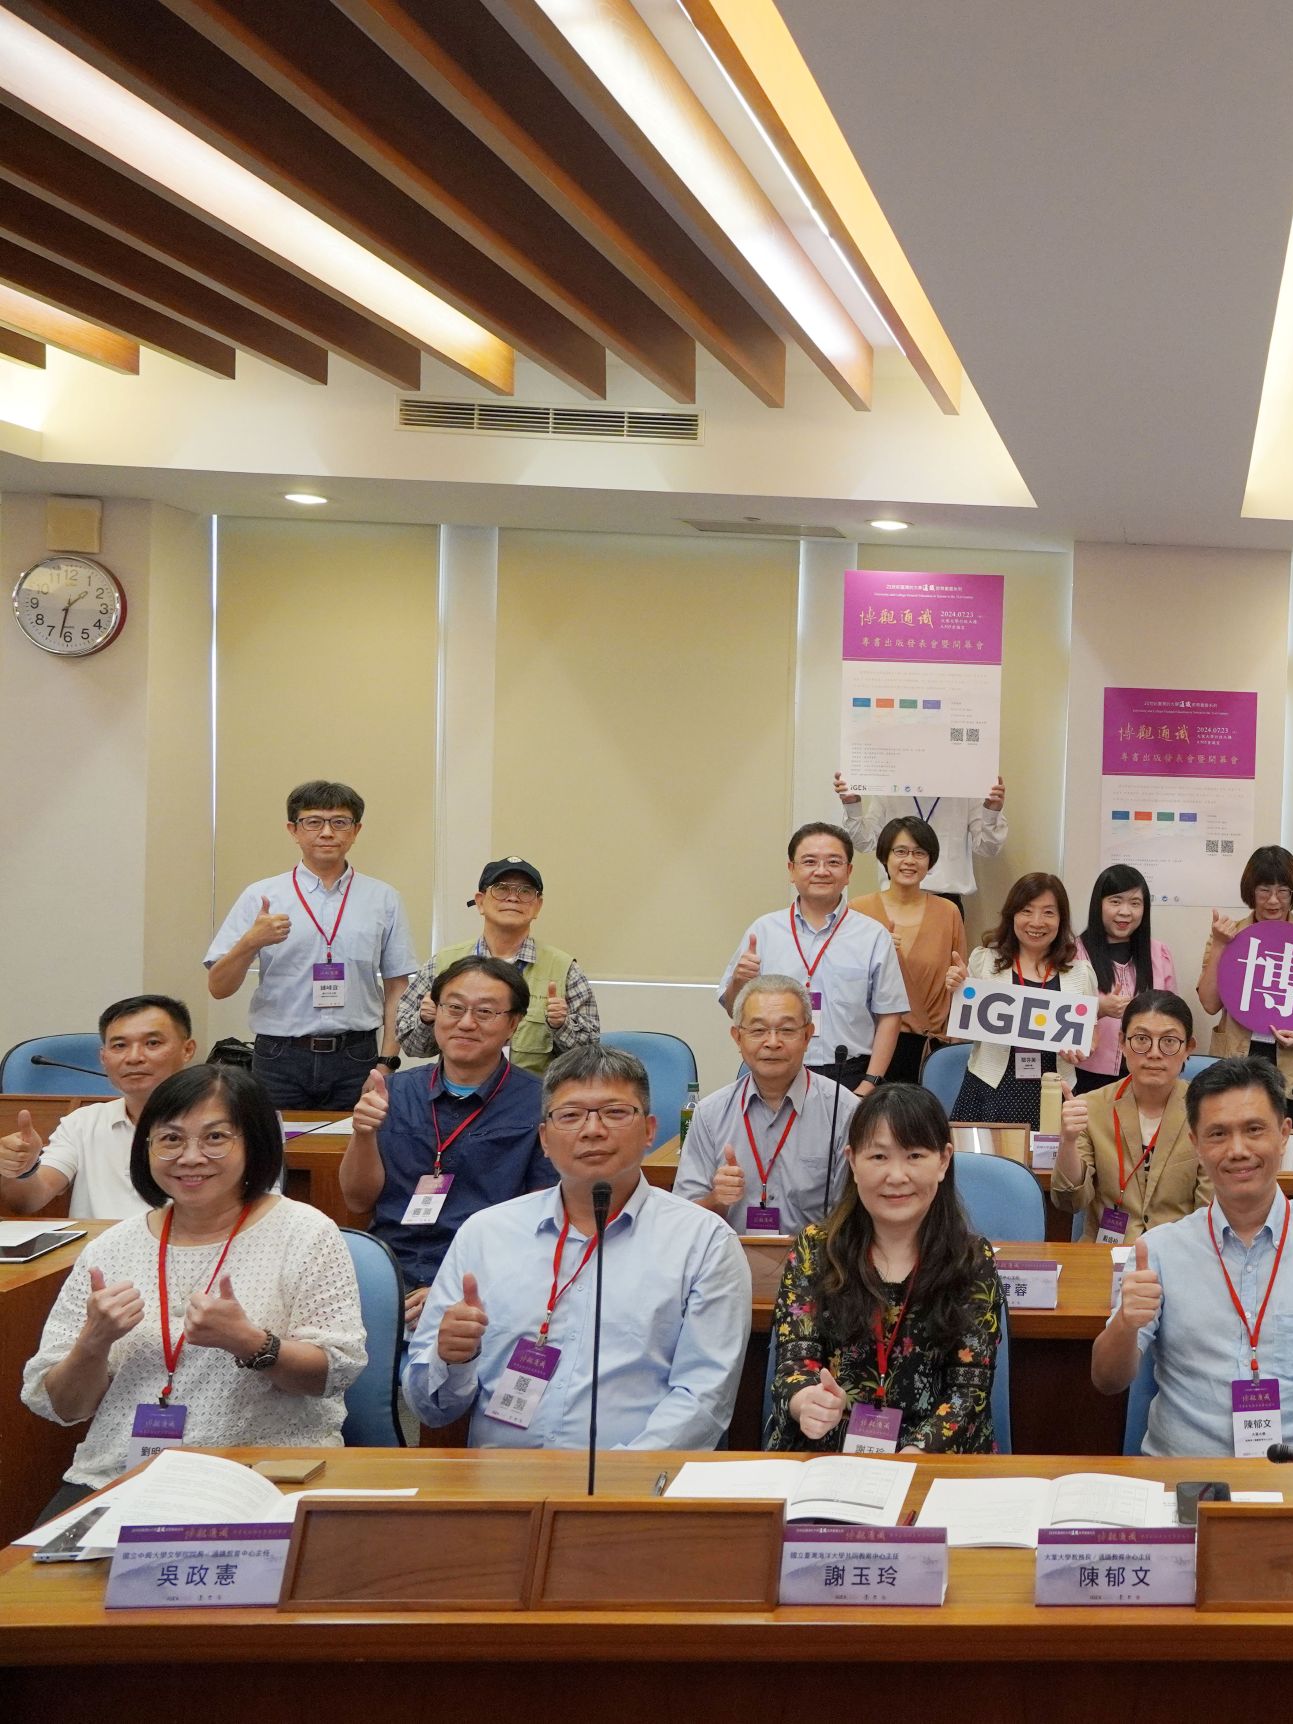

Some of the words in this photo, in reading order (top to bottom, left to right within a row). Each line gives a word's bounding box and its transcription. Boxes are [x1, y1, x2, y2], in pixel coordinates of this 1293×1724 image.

[64, 569, 79, 581] 12
[87, 575, 92, 586] 1
[95, 588, 105, 599] 2
[30, 597, 39, 609] 9
[99, 603, 109, 615] 3
[35, 614, 45, 626] 8
[859, 606, 934, 629] 博觀通識
[93, 619, 103, 630] 4
[46, 625, 55, 637] 7
[63, 631, 73, 643] 6
[81, 628, 90, 640] 5
[1118, 722, 1190, 744] 博觀通識
[1243, 1419, 1272, 1430] 陳郁文
[141, 1446, 166, 1457] 劉明
[156, 1563, 238, 1587] 吳政憲
[824, 1565, 898, 1587] 謝玉玲
[1079, 1566, 1151, 1588] 陳郁文
